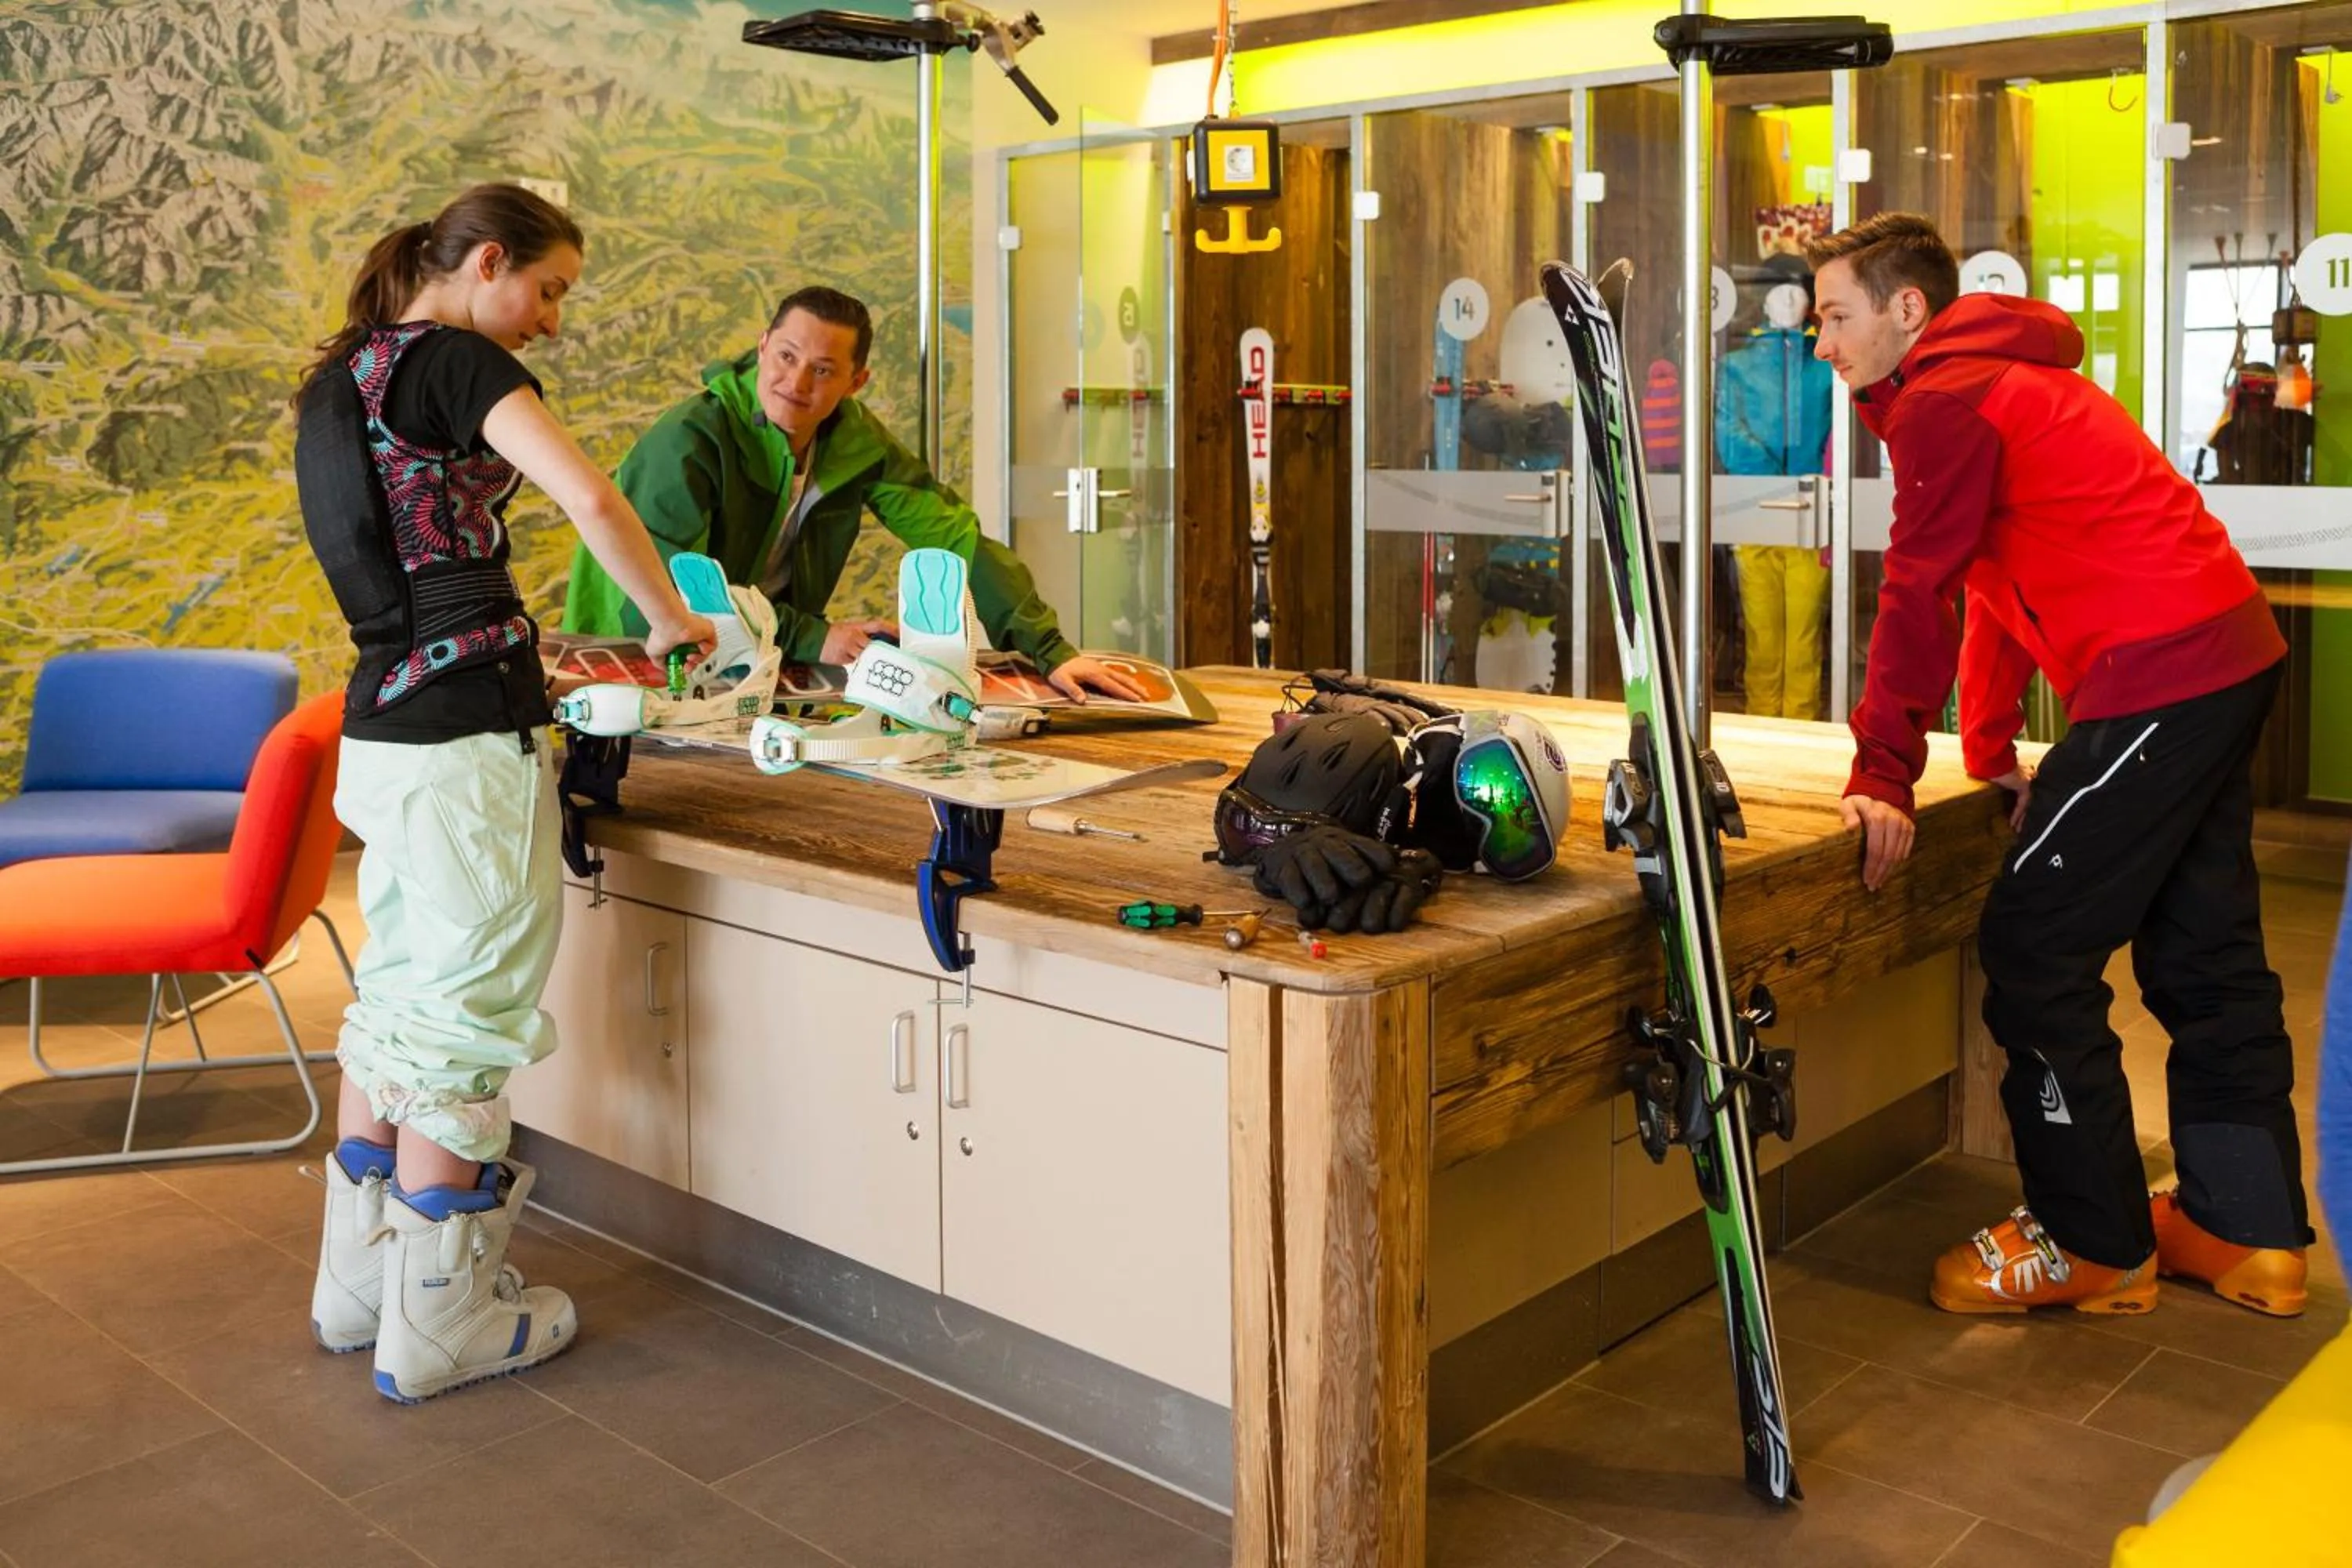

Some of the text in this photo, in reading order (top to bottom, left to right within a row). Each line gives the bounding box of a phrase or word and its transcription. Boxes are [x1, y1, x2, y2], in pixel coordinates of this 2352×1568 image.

[2326, 257, 2350, 289] 11
[1454, 296, 1475, 321] 14
[1250, 346, 1266, 458] HEAD
